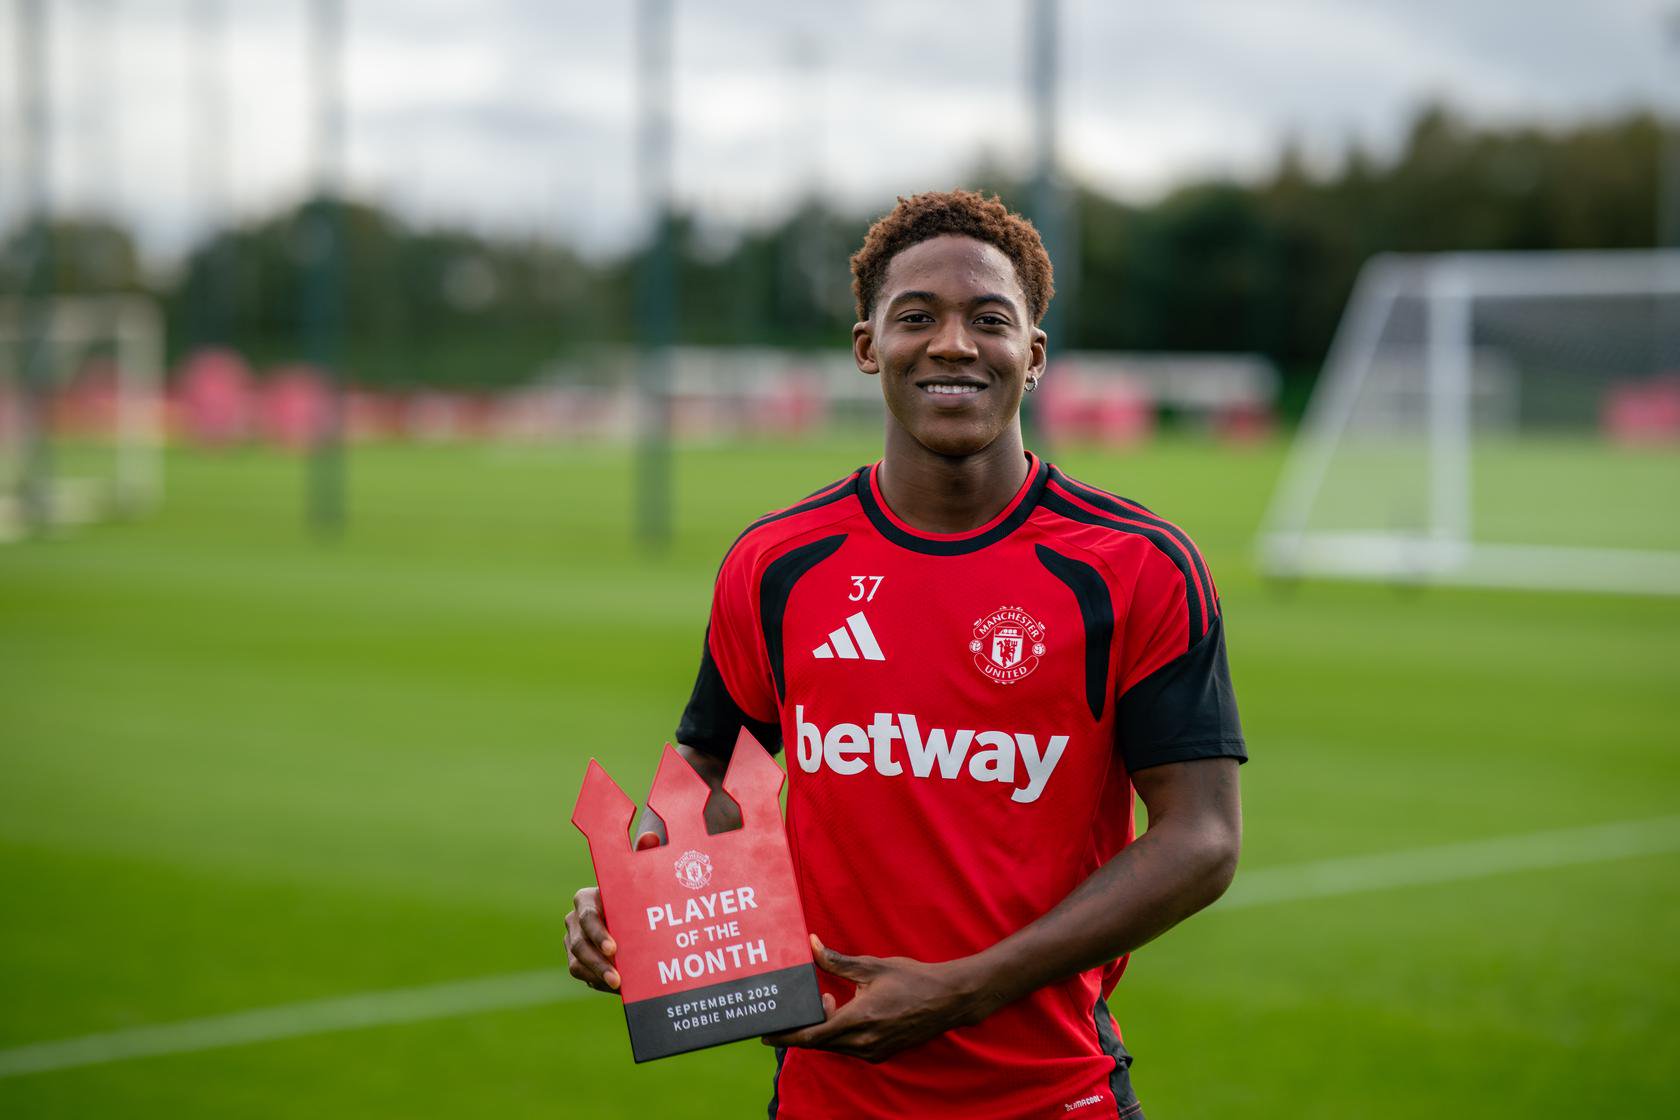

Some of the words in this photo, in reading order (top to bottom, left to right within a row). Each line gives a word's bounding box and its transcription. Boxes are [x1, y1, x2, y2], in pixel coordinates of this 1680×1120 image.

[848, 576, 884, 602] 37
[979, 612, 1040, 638] MANCHESTER
[984, 664, 1027, 679] UNITED
[796, 704, 1070, 803] betway
[646, 886, 758, 930] PLAYER
[676, 930, 699, 948] OF
[704, 920, 740, 941] THE
[658, 939, 768, 984] MONTH
[667, 992, 743, 1018] SEPTEMBER
[748, 984, 778, 1000] 2026
[673, 1012, 720, 1032] KOBBIE
[725, 1000, 777, 1019] MAINOO
